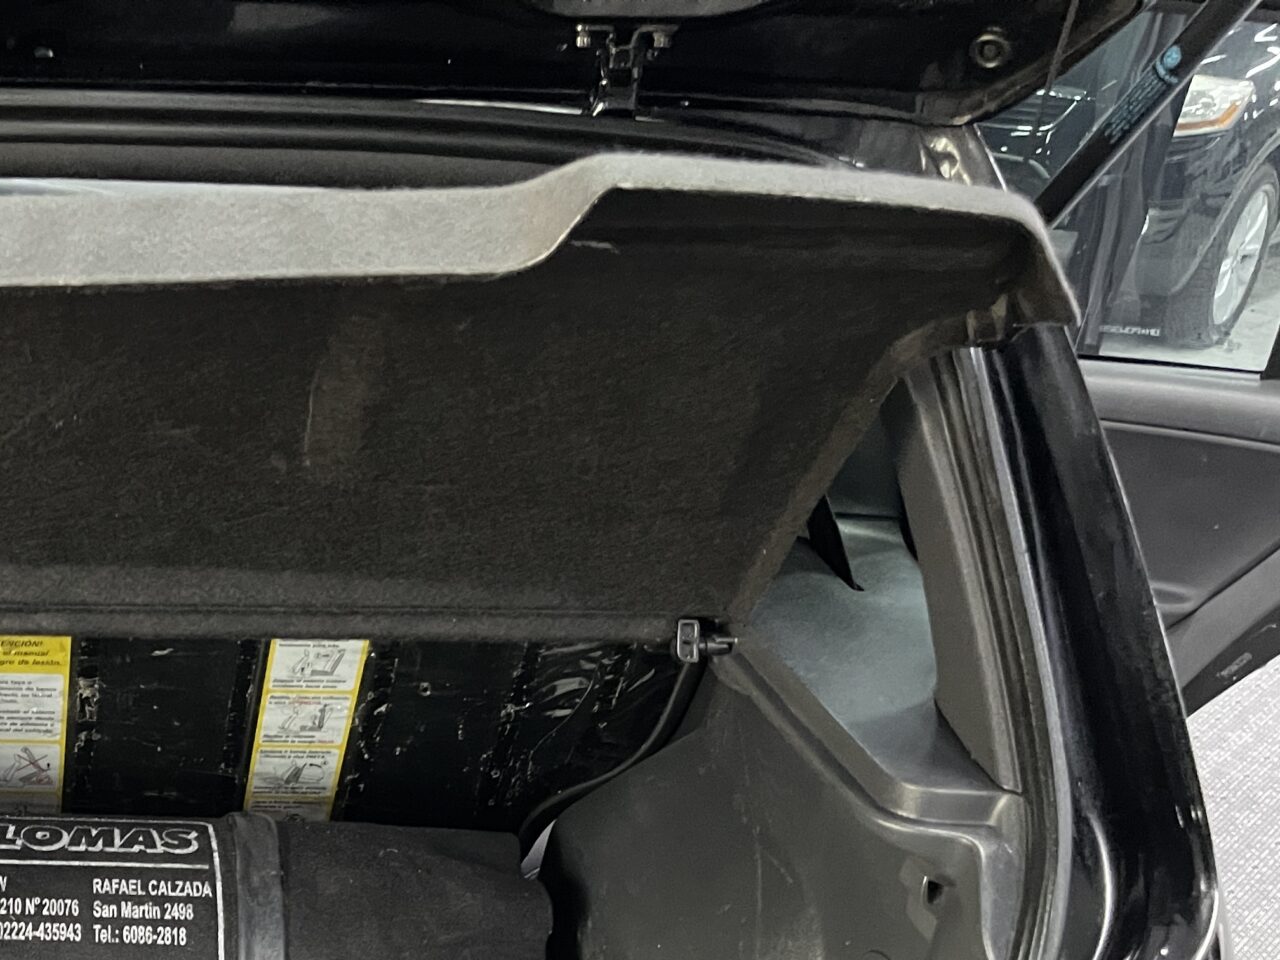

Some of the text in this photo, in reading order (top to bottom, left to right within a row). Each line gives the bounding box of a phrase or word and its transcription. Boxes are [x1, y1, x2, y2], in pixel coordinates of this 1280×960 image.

[92, 878, 213, 898] RAFAEL CALZADA
[0, 897, 22, 915] 210
[41, 898, 80, 917] 20076
[92, 900, 194, 920] San Martin 2498
[92, 924, 187, 946] Tel.: 6086-2818
